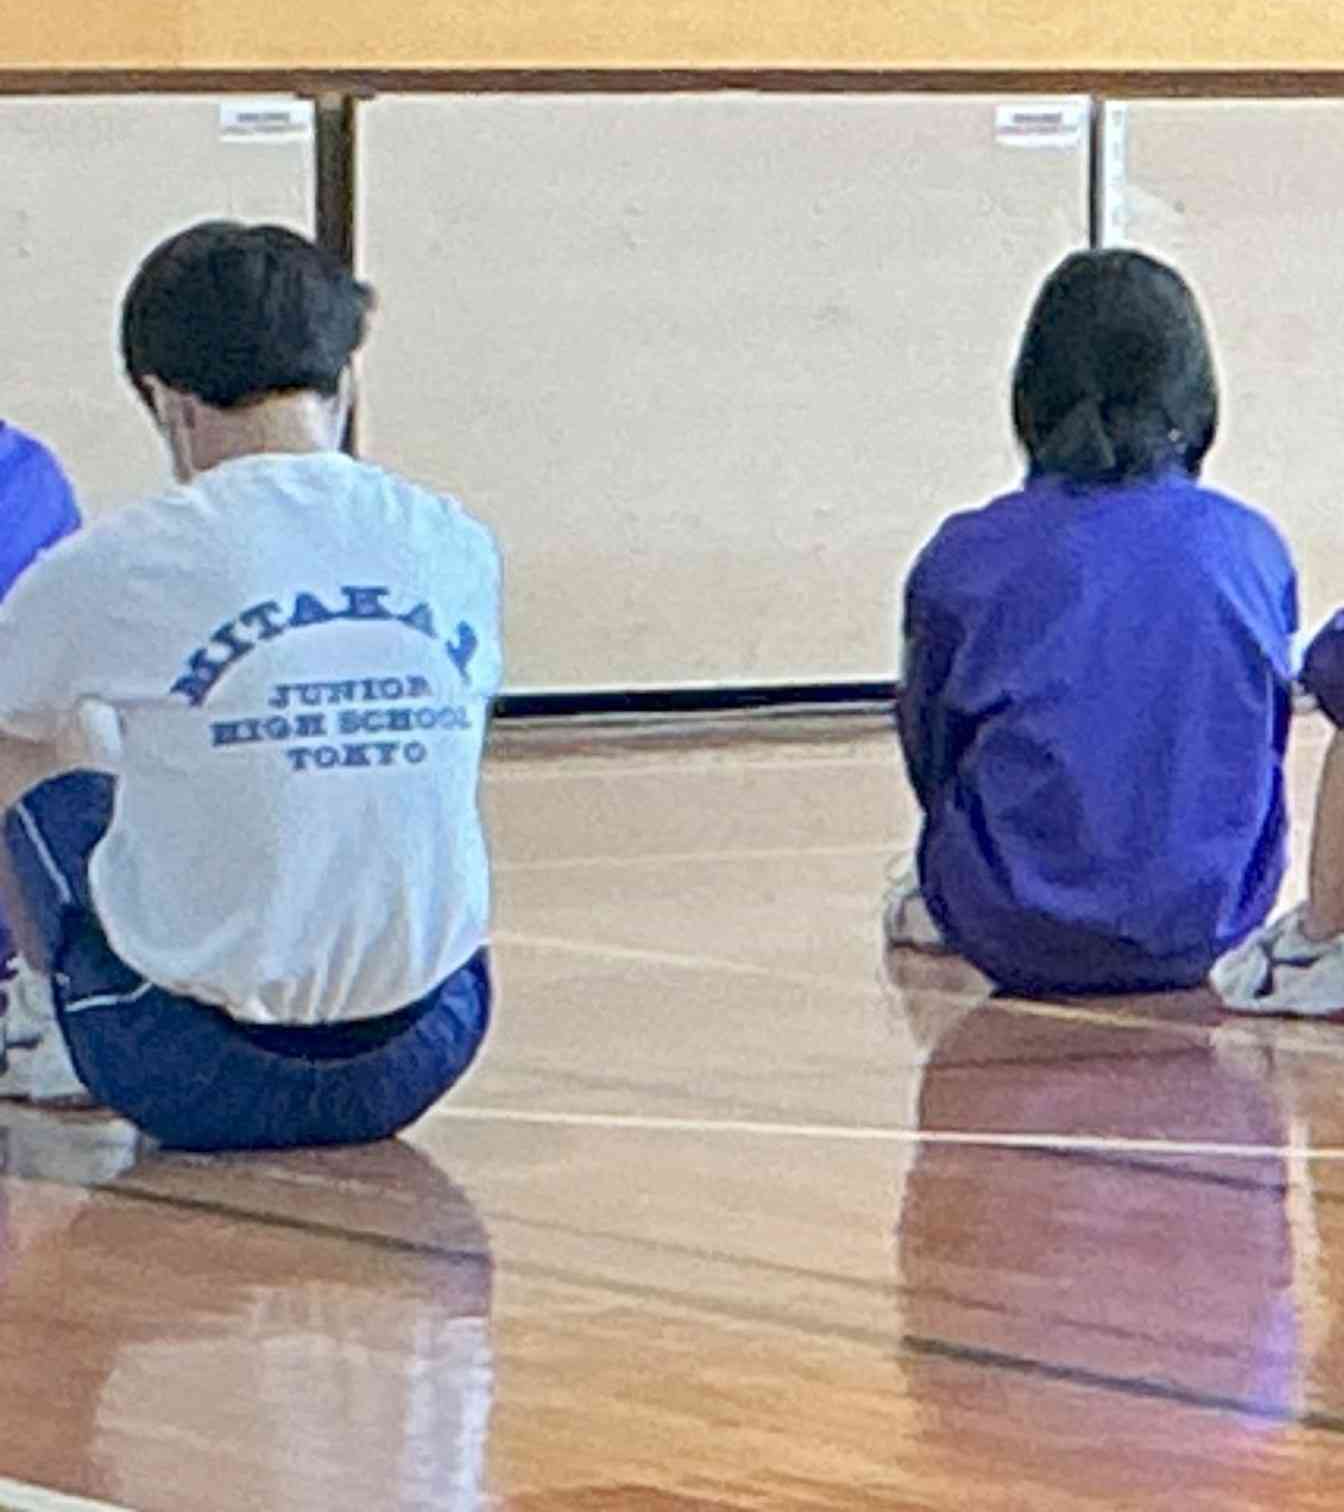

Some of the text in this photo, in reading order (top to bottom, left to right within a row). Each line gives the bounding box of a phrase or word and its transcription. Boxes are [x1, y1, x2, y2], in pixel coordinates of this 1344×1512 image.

[170, 585, 439, 709] MITAKA
[268, 674, 431, 709] JUNIOR
[210, 705, 471, 746] HIGH SCHOOL
[286, 740, 427, 771] TOKYO
